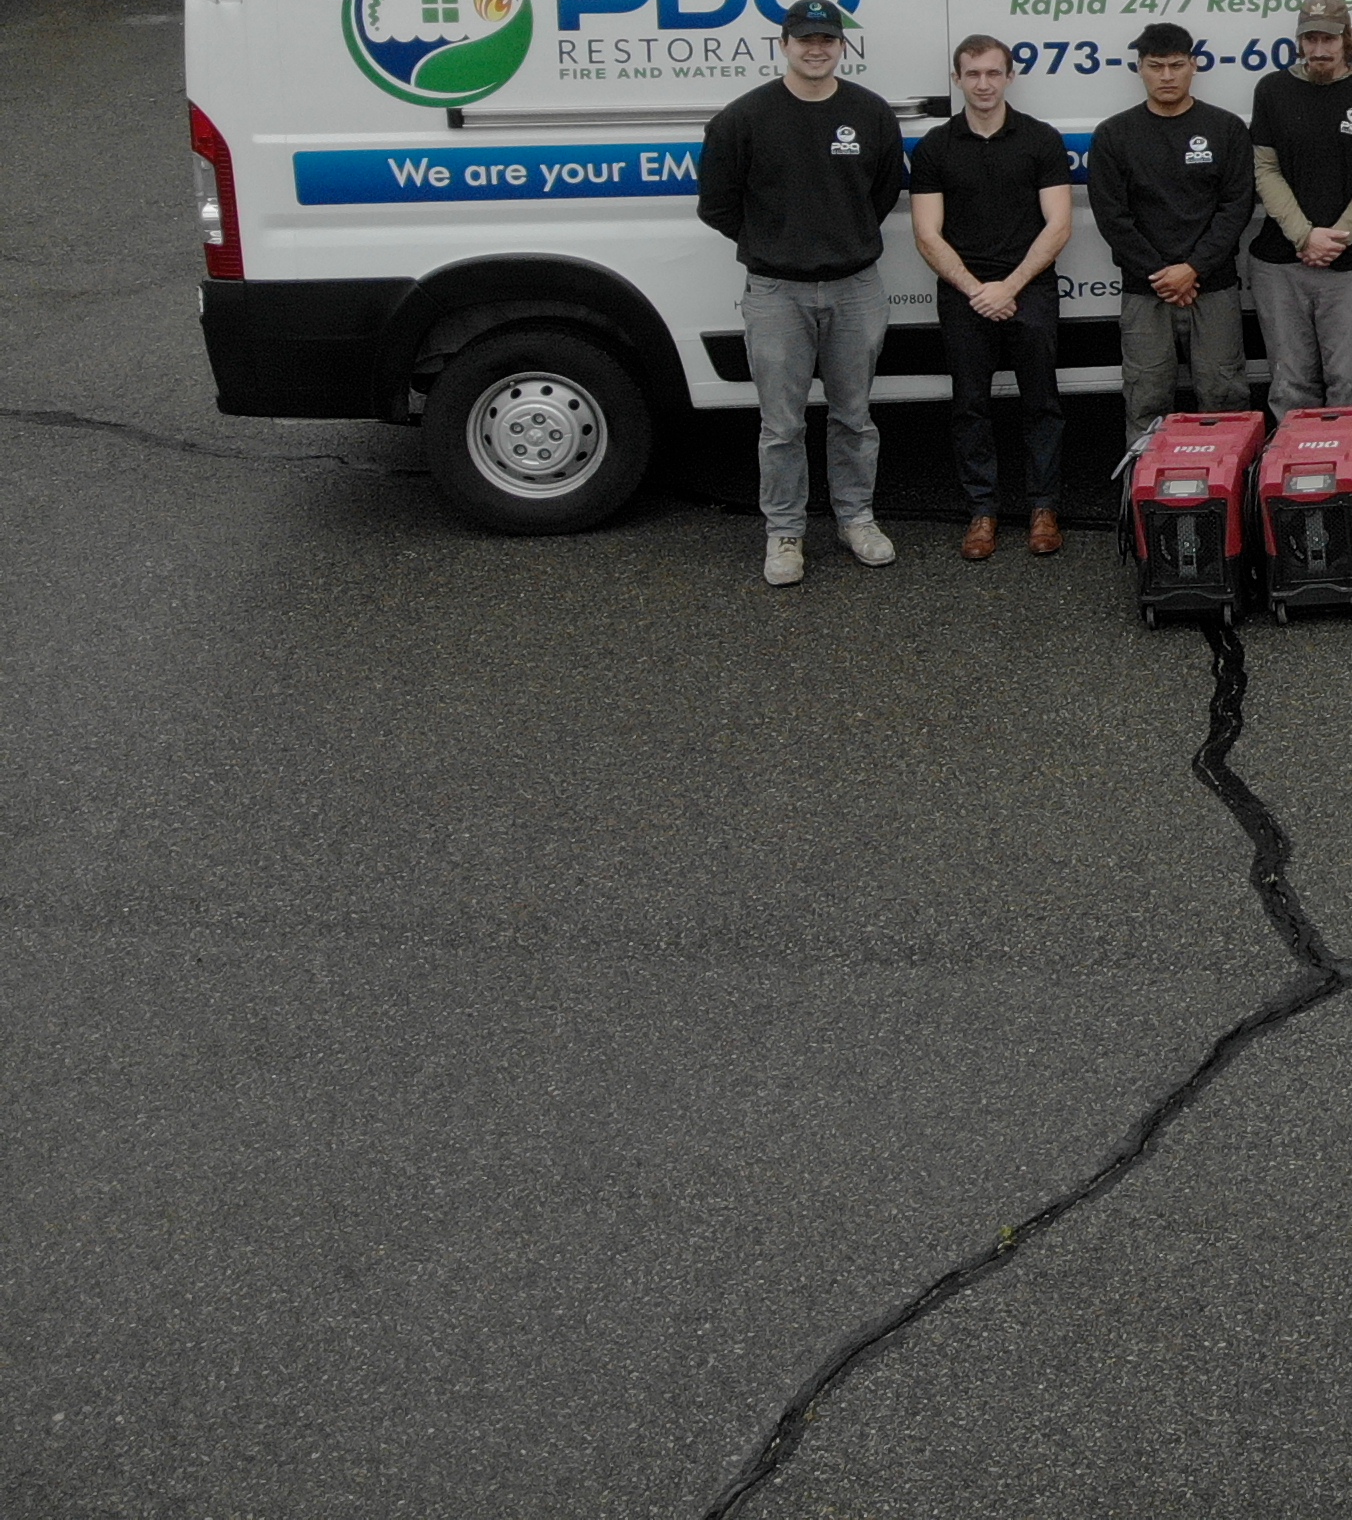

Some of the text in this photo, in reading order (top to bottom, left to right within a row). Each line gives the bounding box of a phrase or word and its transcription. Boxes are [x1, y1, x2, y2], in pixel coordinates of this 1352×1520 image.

[558, 36, 866, 64] RESTORATN
[559, 63, 868, 80] FIRE AND WATER CLUP
[831, 142, 861, 152] PDQ
[1185, 151, 1213, 160] PDQ
[388, 157, 450, 189] We
[465, 162, 528, 187] are
[539, 162, 626, 193] your
[1174, 445, 1216, 453] PDQ
[1298, 440, 1340, 449] PDQ
